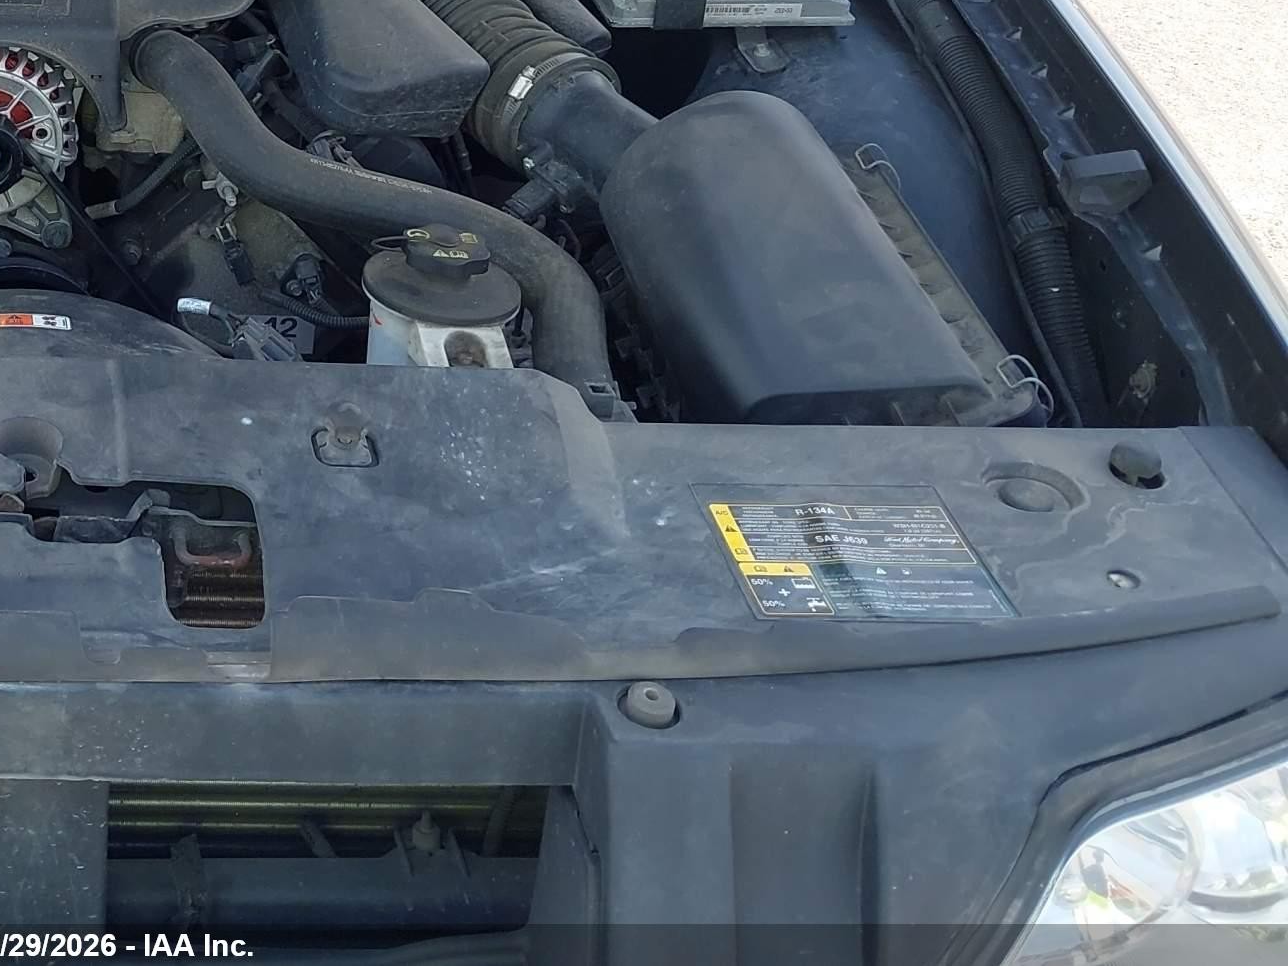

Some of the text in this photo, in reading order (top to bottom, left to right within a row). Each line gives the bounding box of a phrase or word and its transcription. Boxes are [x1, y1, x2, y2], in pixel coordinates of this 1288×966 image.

[795, 507, 835, 516] R-134A
[814, 535, 840, 543] SAE
[842, 535, 868, 545] J639
[751, 578, 773, 586] 50%
